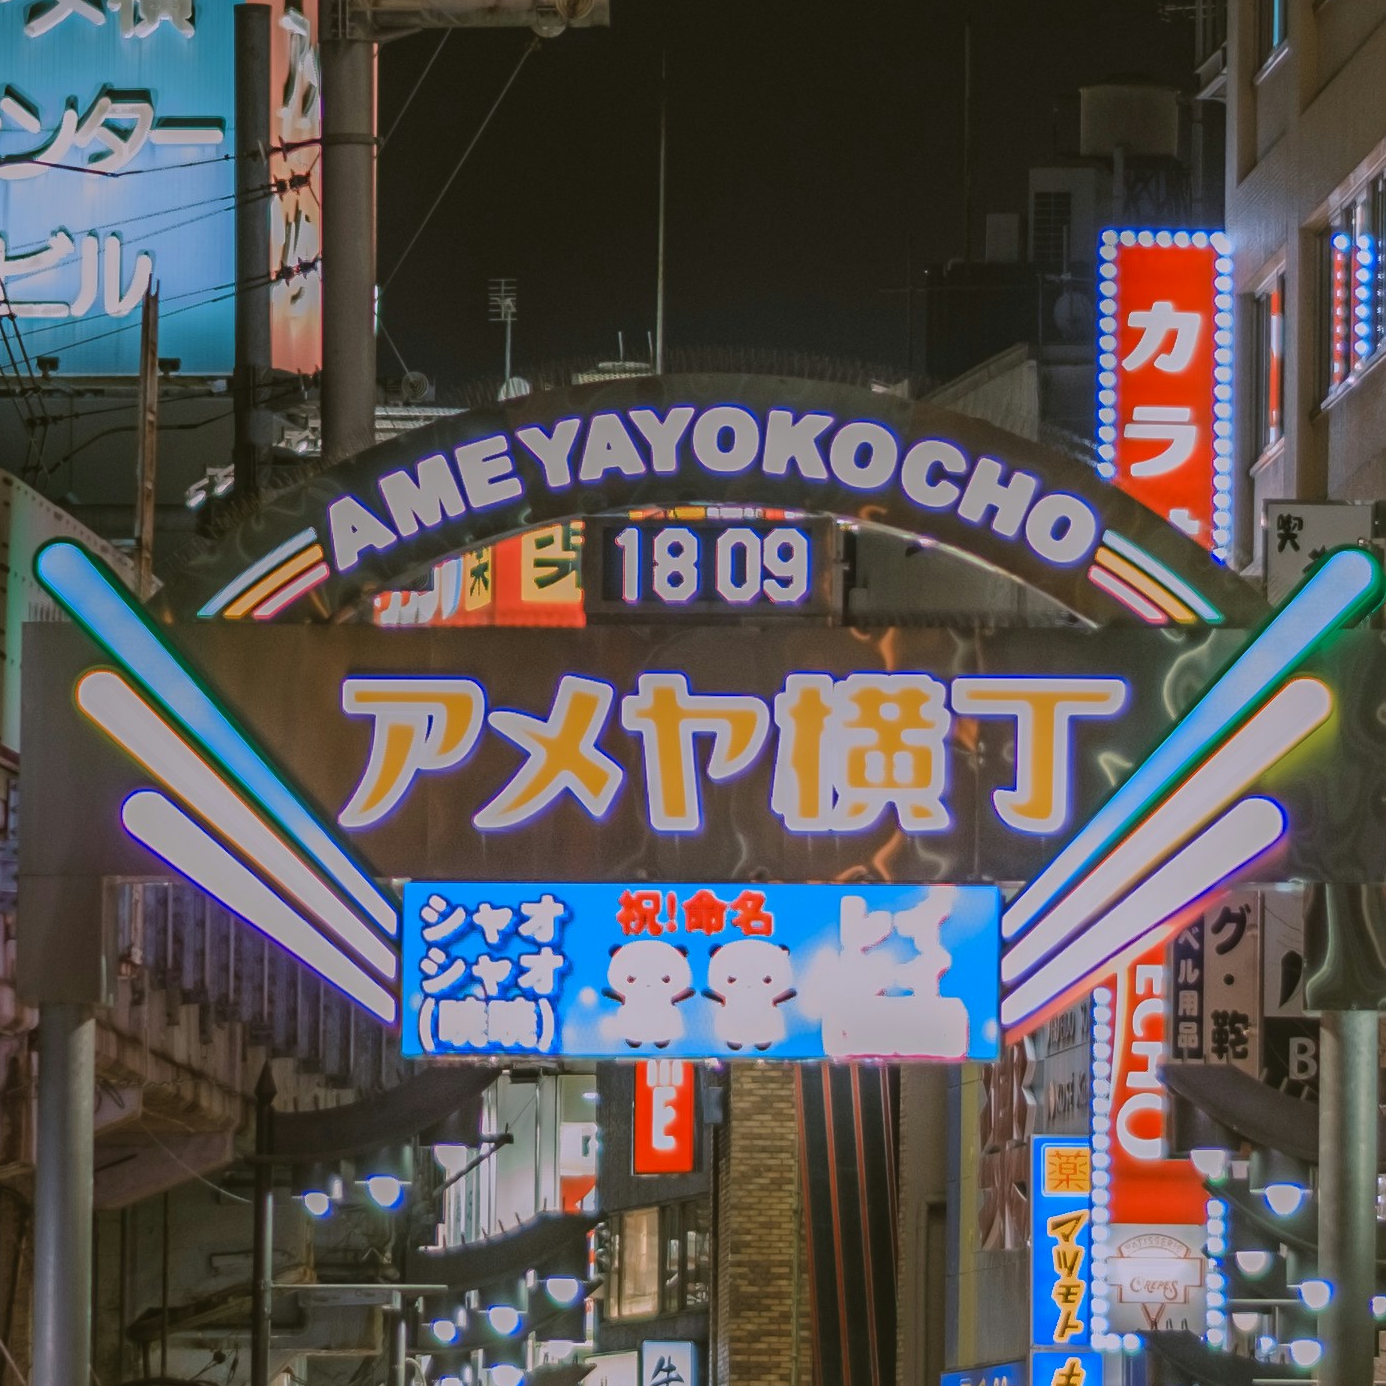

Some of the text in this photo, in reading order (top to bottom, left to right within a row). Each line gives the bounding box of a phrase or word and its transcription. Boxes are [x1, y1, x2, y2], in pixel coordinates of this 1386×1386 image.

[1121, 301, 1203, 535] カラ
[324, 405, 1102, 570] AMEYAYOKOCHO
[615, 527, 698, 603] 18
[716, 527, 809, 603] 09
[339, 671, 1127, 832] アメヤ横丁
[419, 894, 566, 945] シャオ
[617, 888, 774, 938] 祝!命名
[419, 947, 566, 997] シャオ
[1047, 1150, 1088, 1190] 薬
[1129, 1275, 1179, 1301] CREPES
